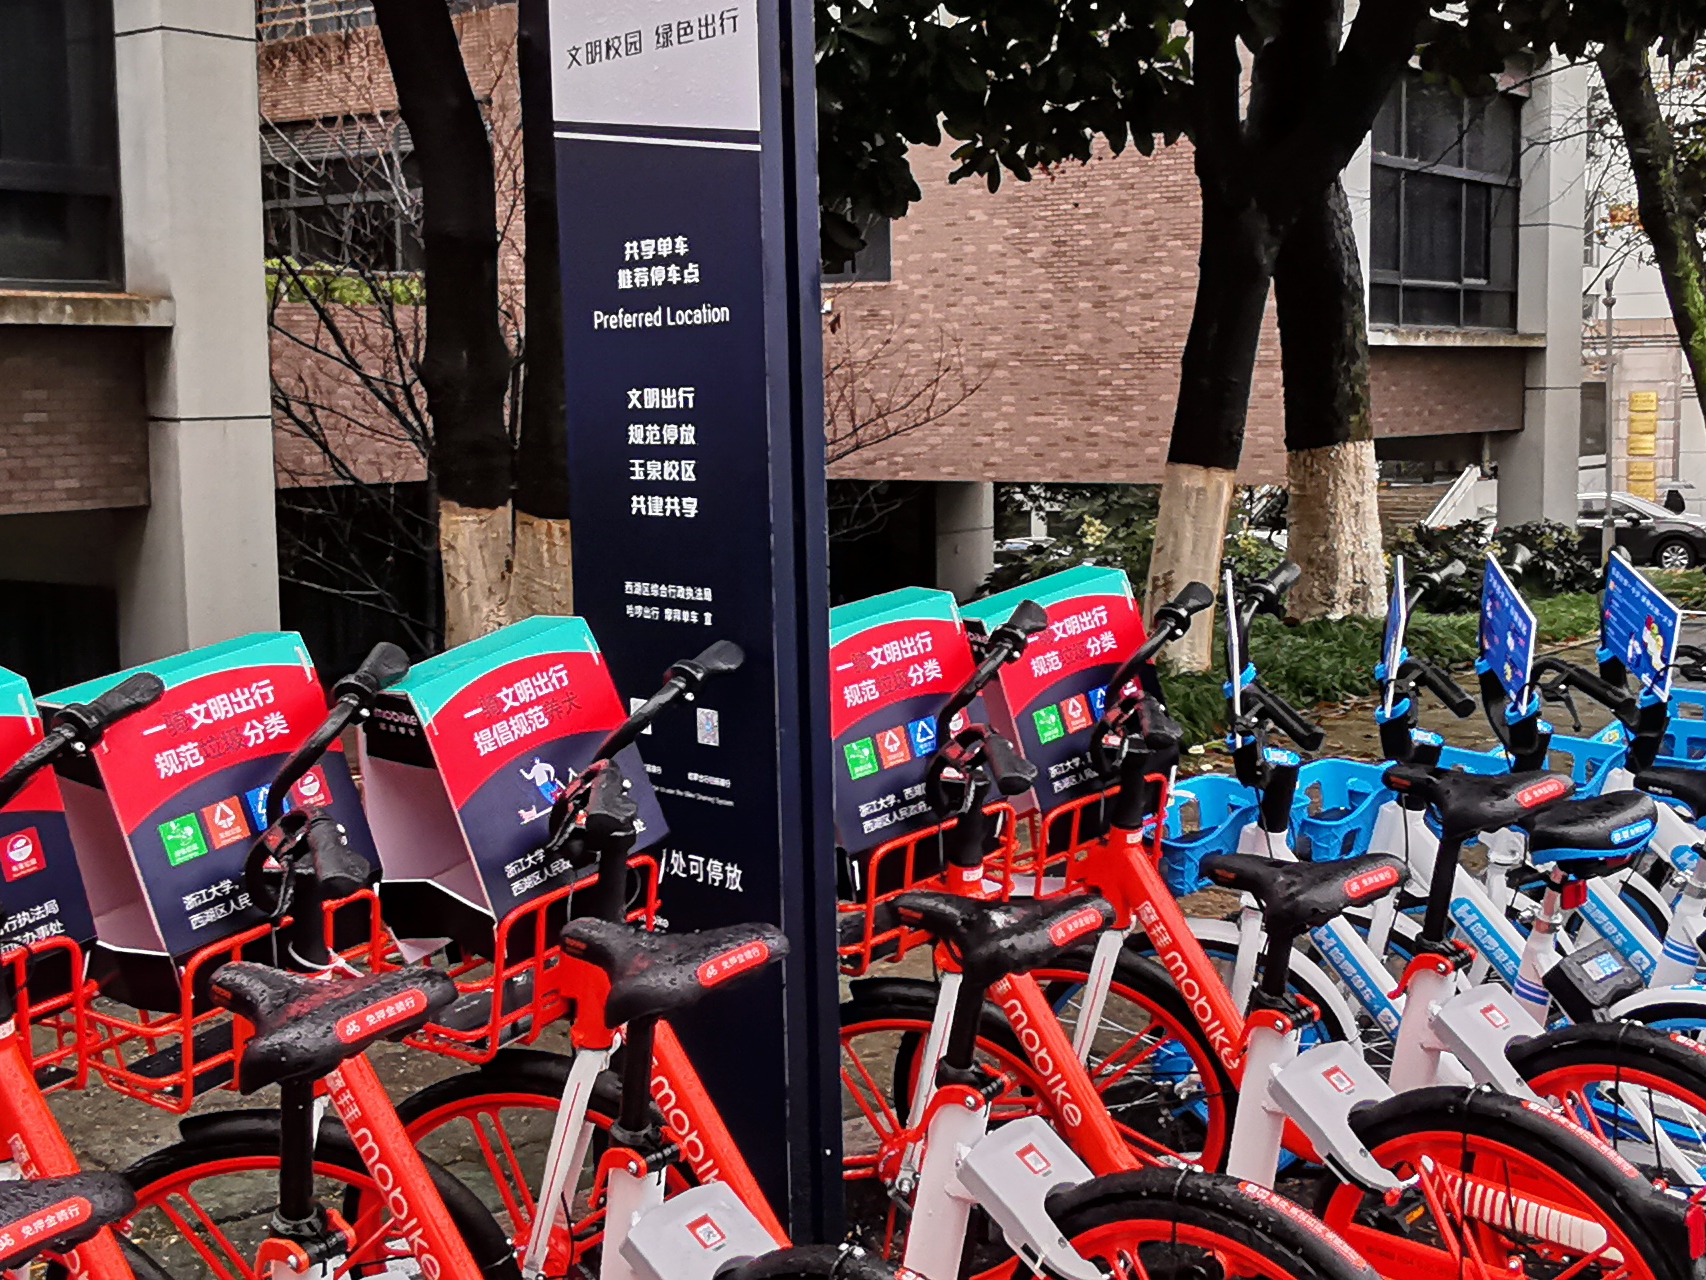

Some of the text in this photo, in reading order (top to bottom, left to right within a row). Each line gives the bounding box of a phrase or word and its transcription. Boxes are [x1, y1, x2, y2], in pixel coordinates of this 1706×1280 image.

[566, 6, 741, 70] 文明校园 绿色出行
[624, 235, 690, 260] 共享单车
[617, 262, 701, 290] 推荐停车点
[593, 302, 731, 331] Preferred Location
[626, 387, 695, 410] 文明出行
[627, 423, 697, 447] 规范停放
[629, 459, 698, 483] 玉泉校区
[630, 495, 700, 519] 共建共享
[624, 581, 713, 602] 西湖区综合行政执法局
[835, 630, 934, 674] 一骑文明出行
[463, 663, 570, 720] 一骑文明出行
[843, 659, 944, 708] 规范垃圾分类
[142, 678, 276, 737] 一骑文明出行
[473, 690, 584, 758] 提倡规范养犬
[154, 710, 291, 780] 规范垃圾分类
[665, 849, 744, 893] 处可停放
[1165, 949, 1241, 1072] mobike
[1004, 998, 1083, 1128] mobike
[20, 1203, 81, 1239] 免押金骑行
[355, 1127, 441, 1280] mobike
